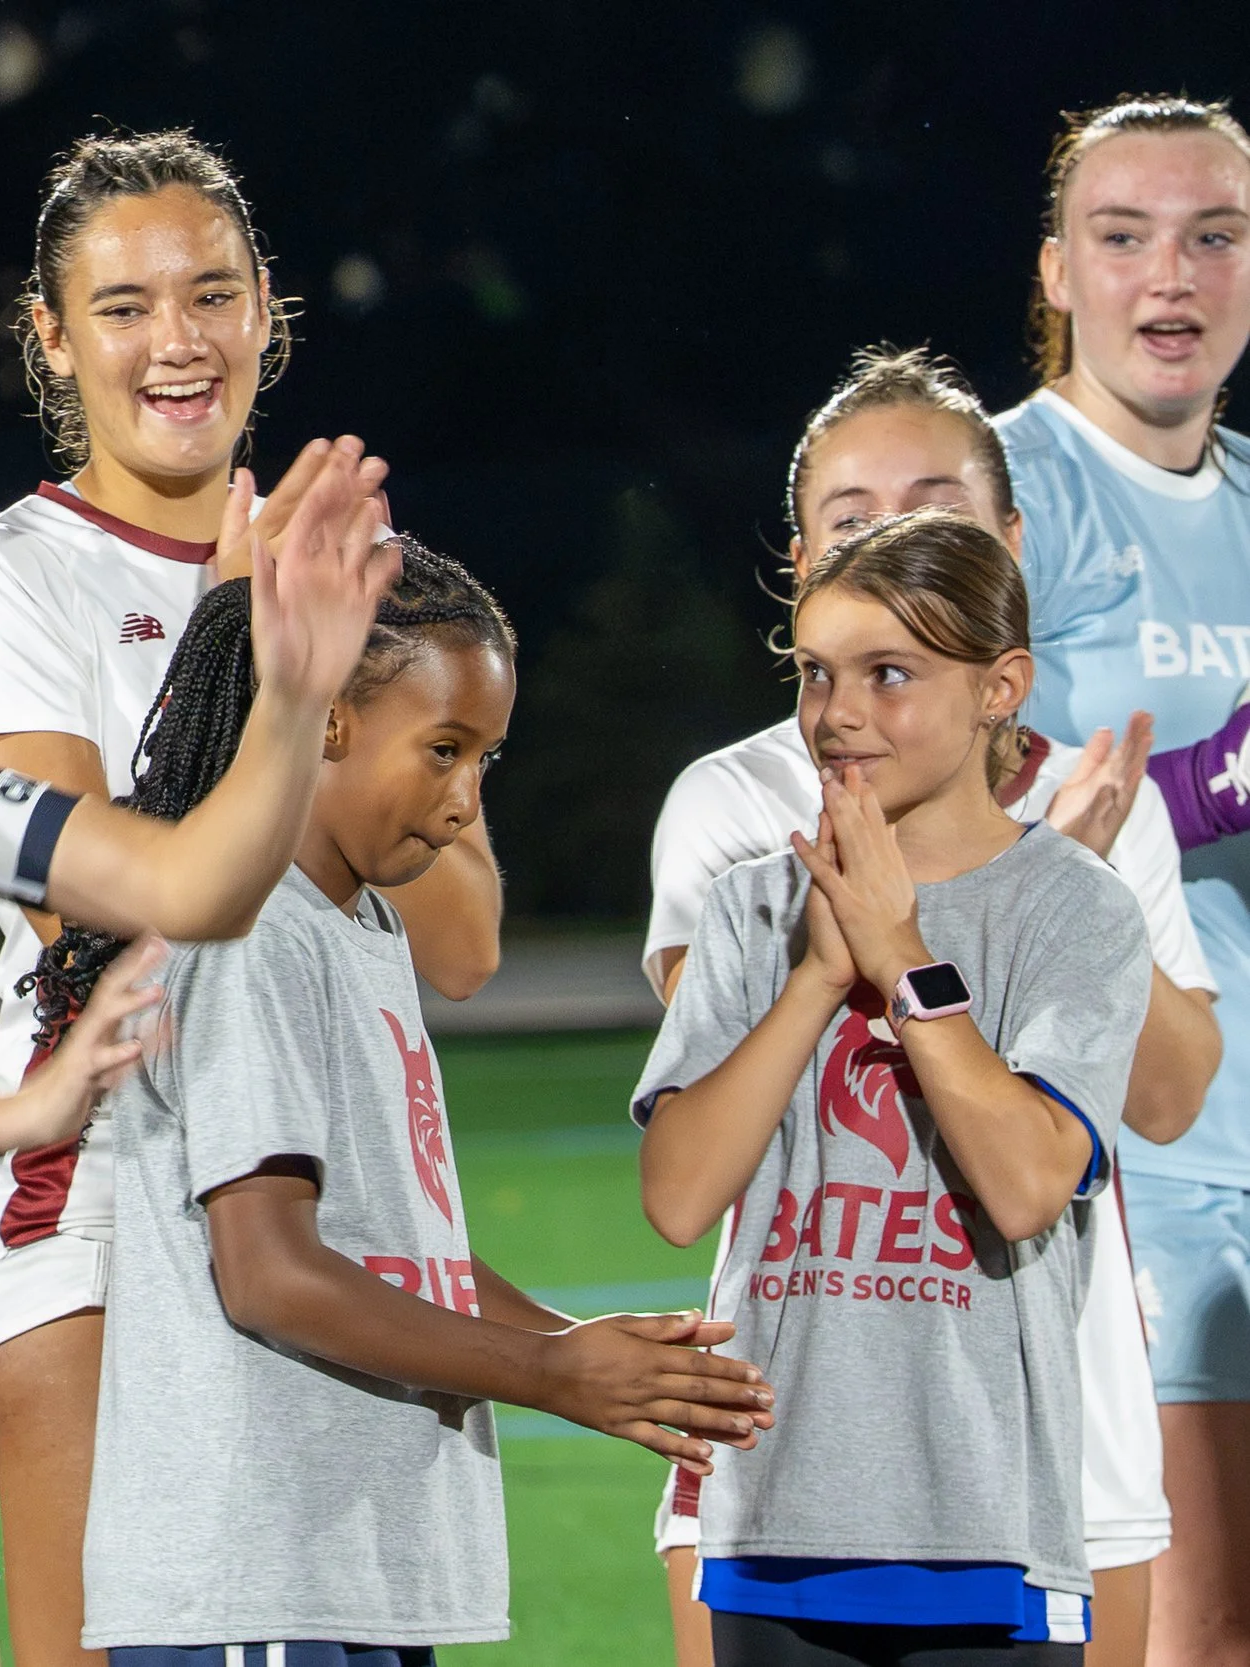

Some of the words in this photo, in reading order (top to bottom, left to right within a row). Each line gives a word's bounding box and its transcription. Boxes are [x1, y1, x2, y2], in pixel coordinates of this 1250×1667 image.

[760, 1181, 976, 1271] BATES
[748, 1269, 845, 1301] WOEN'S
[853, 1274, 971, 1311] SOCCER
